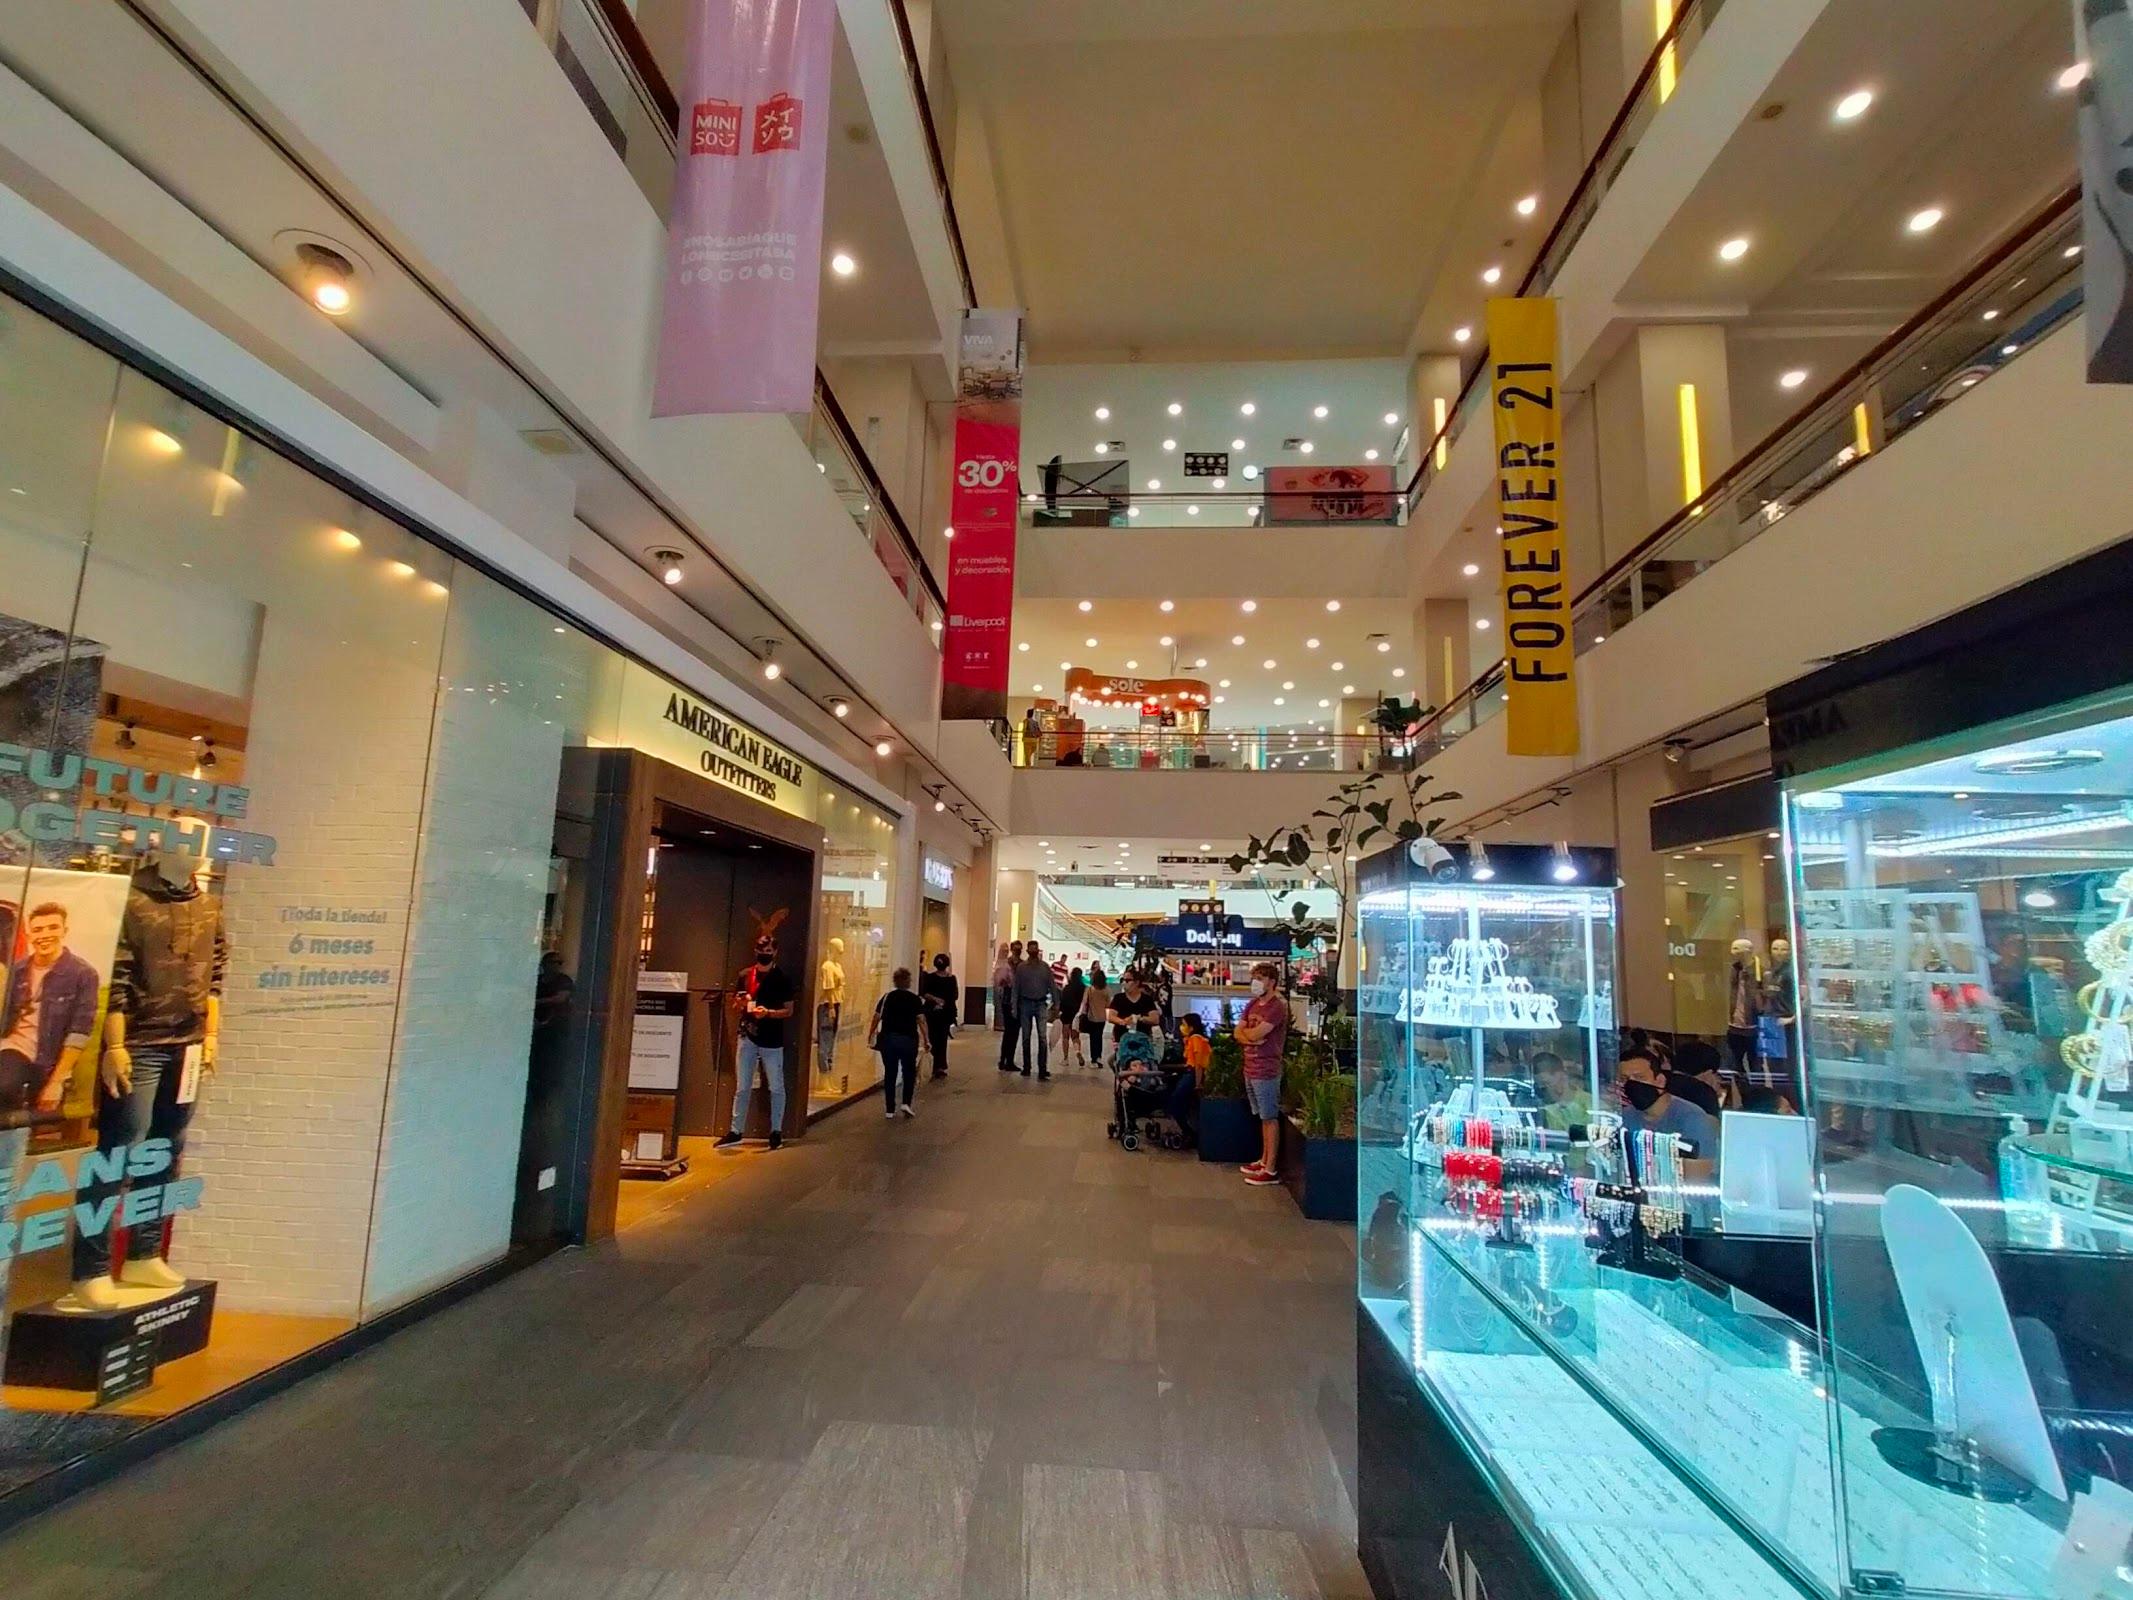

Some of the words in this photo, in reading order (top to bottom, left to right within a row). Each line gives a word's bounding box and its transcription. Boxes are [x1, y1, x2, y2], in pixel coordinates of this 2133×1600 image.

[696, 114, 737, 131] MINI
[964, 335, 993, 346] VIVA
[1496, 361, 1553, 411] 21
[958, 460, 1017, 488] 30%
[970, 556, 1007, 564] muebles
[1500, 441, 1568, 683] FOREVER
[954, 568, 961, 576] y
[964, 616, 1006, 628] Liverpool
[663, 692, 761, 766] AMERICAN
[761, 744, 803, 788] EAGLE
[700, 750, 776, 801] OUTFITTERS
[326, 908, 338, 921] la
[288, 933, 304, 955] 6
[309, 938, 375, 955] meses
[258, 965, 292, 989] sin
[297, 965, 390, 987] intereses
[133, 1295, 201, 1326] ATHLETIC
